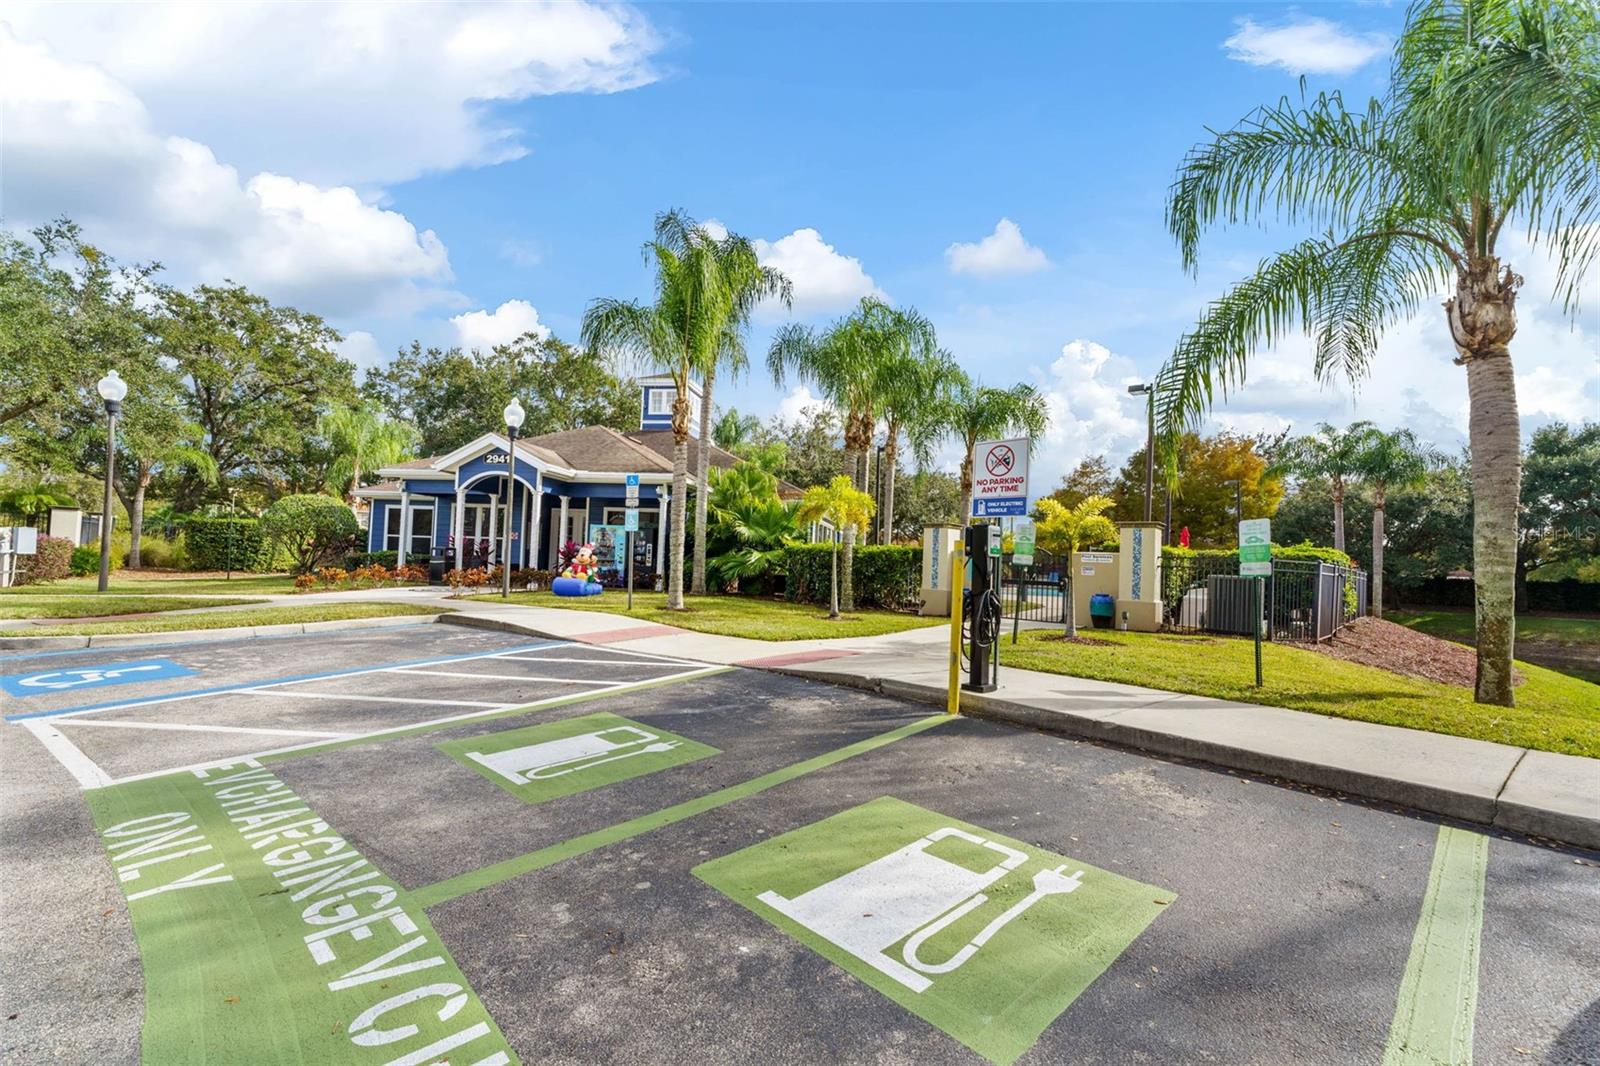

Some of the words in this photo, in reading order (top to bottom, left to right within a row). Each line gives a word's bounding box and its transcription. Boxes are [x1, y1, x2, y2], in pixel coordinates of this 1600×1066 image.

[486, 454, 511, 464] 2941
[976, 479, 988, 487] NO
[989, 476, 1025, 486] PARKING
[981, 486, 998, 494] ANY
[1000, 485, 1019, 493] TIME
[103, 811, 235, 901] ONLY
